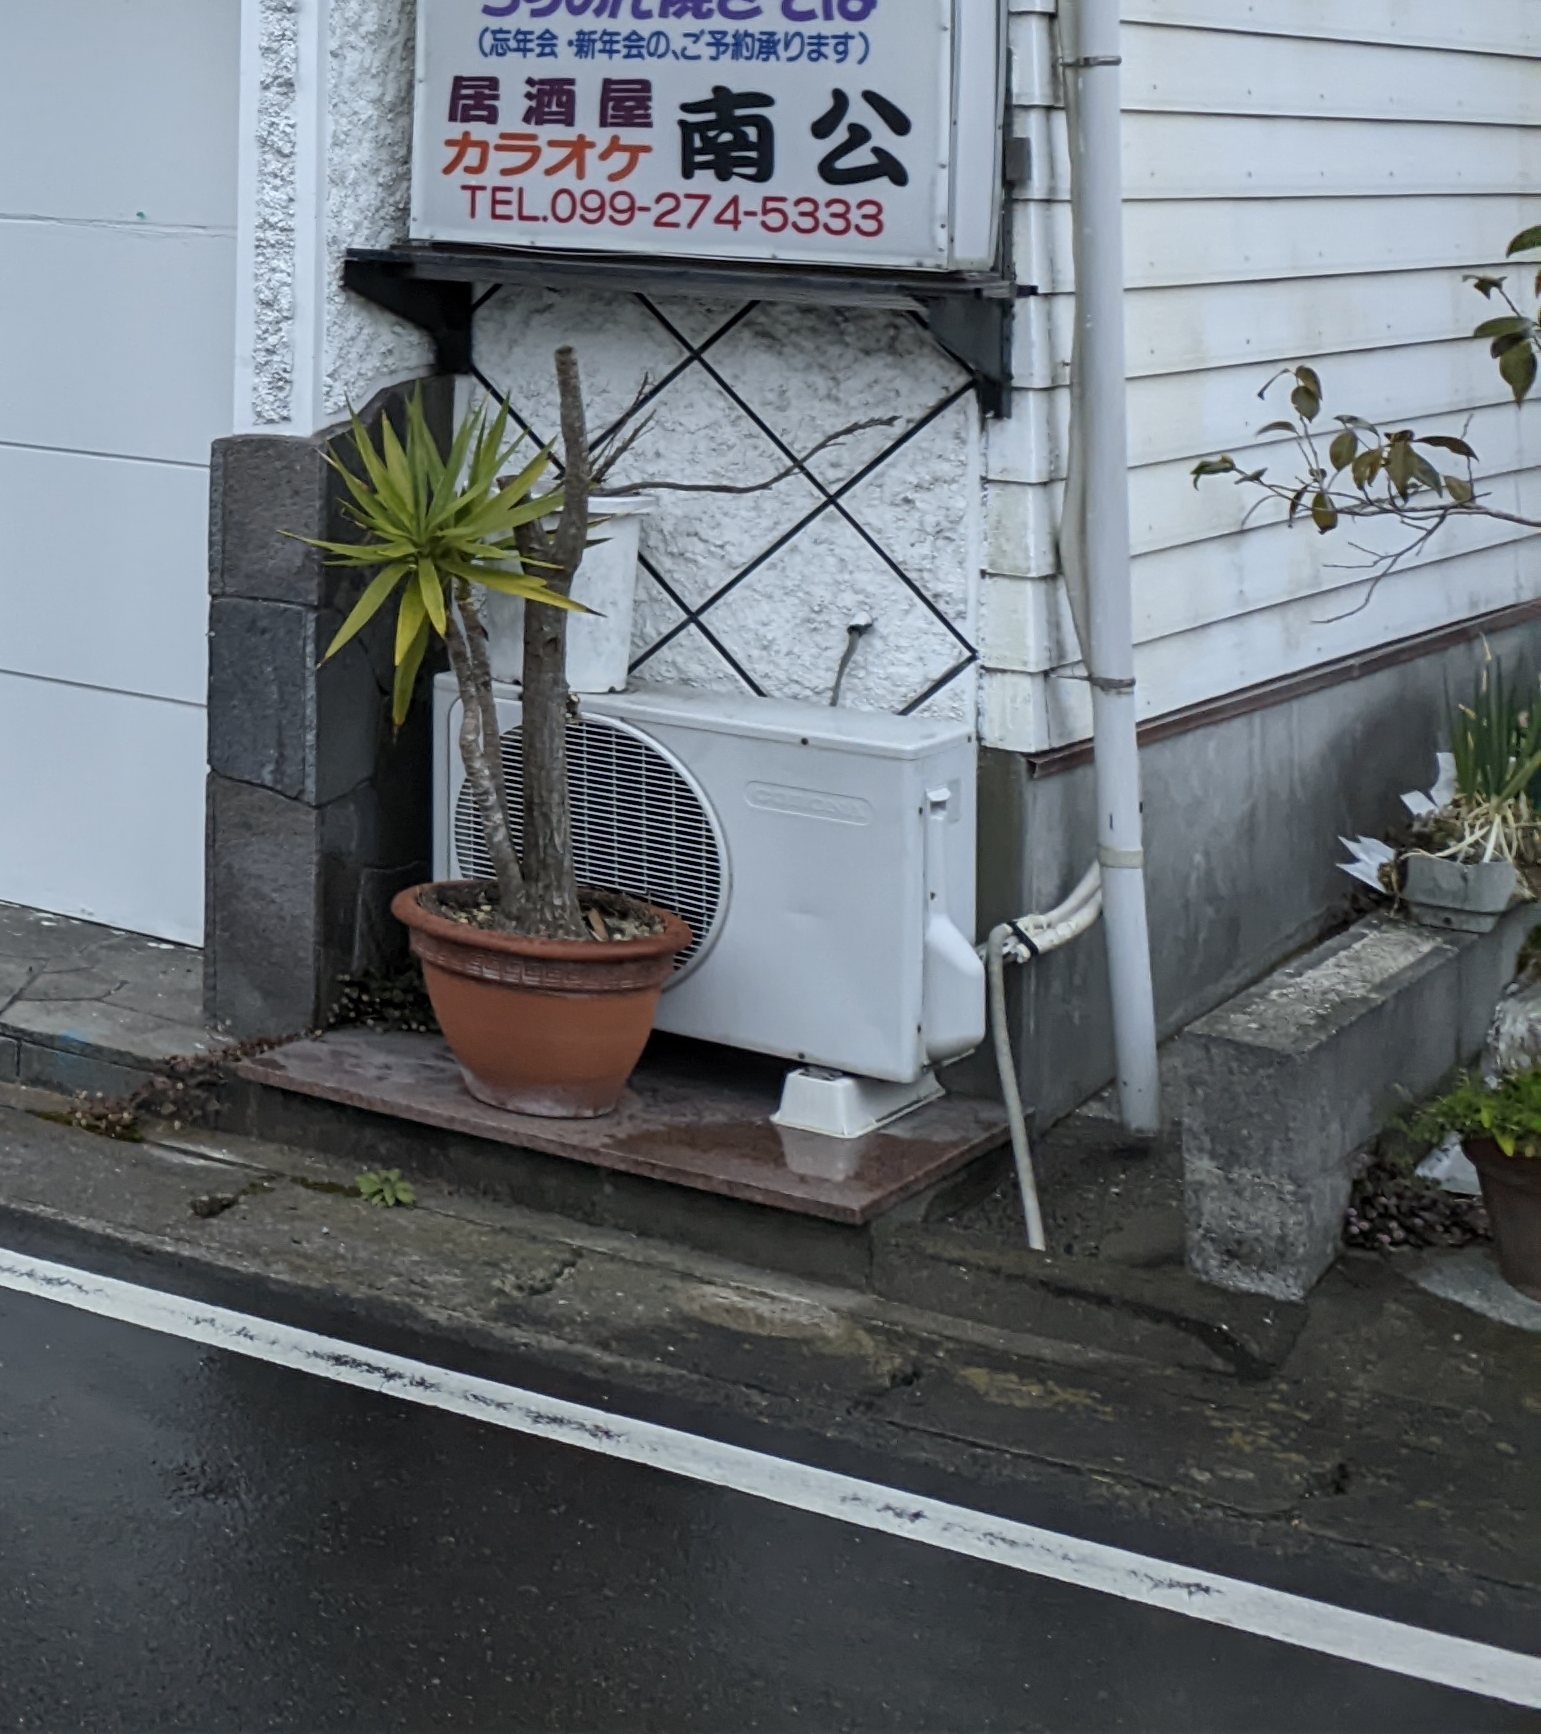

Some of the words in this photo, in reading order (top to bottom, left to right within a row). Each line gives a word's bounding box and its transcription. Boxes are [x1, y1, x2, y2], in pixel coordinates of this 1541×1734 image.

[447, 74, 655, 130] 居酒屋
[442, 131, 654, 182] カラオケ
[677, 84, 913, 187] 南公
[460, 184, 884, 237] TEL.099-274-5333
